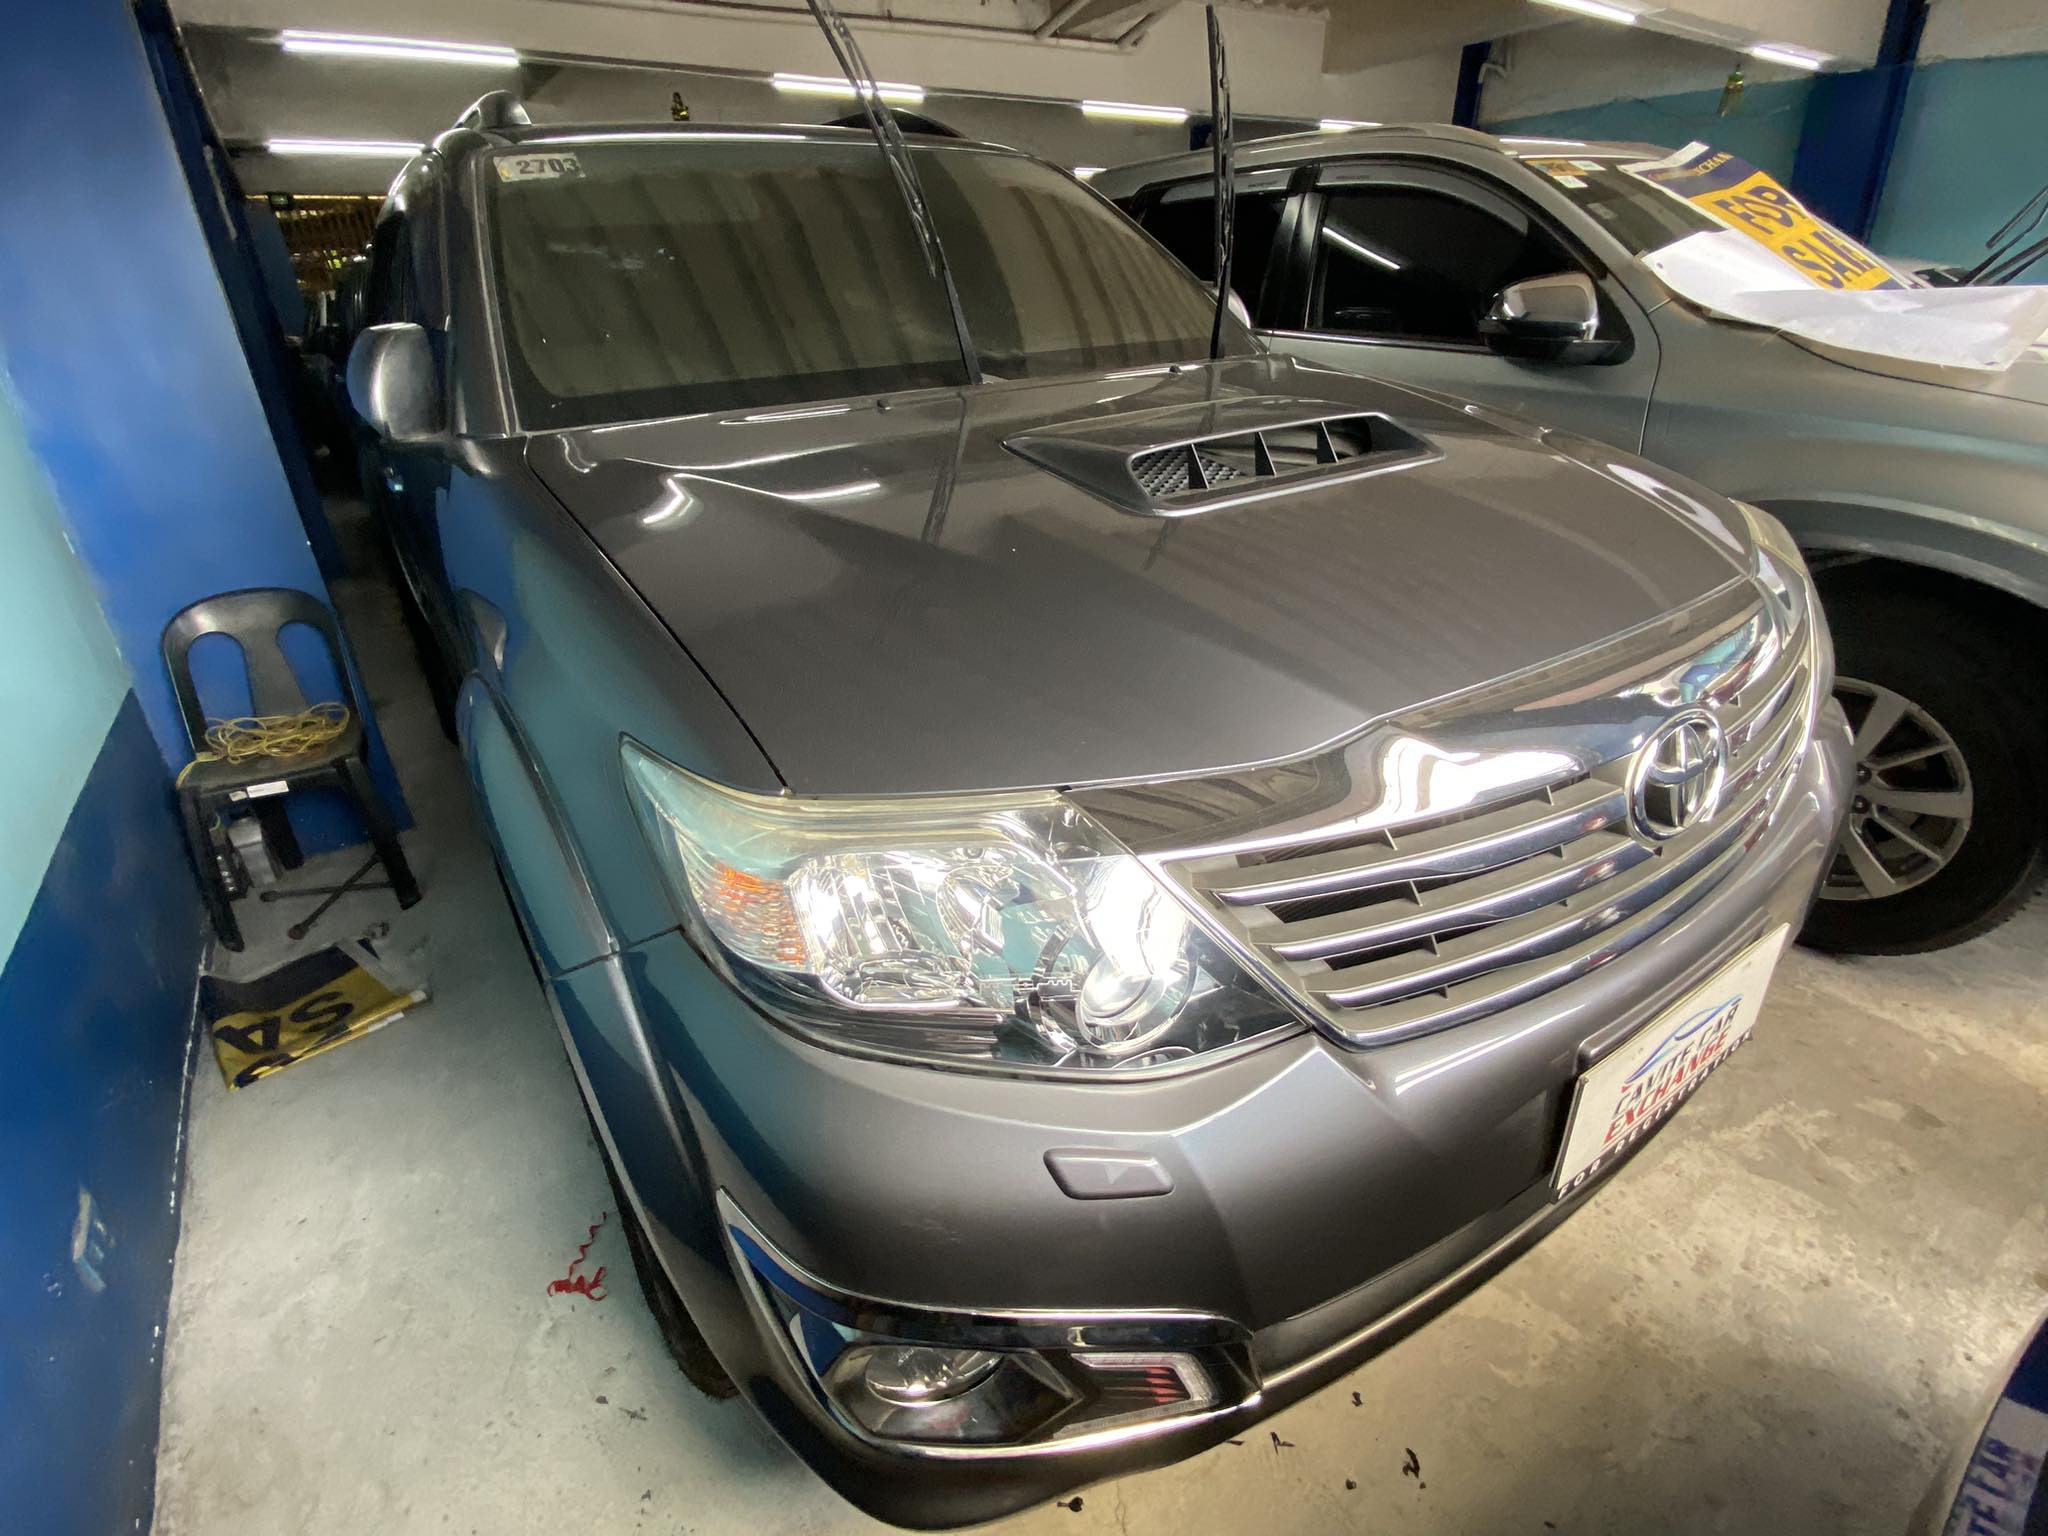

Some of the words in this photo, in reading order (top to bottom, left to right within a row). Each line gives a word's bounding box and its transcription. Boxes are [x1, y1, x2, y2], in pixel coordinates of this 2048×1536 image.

[1712, 185, 1807, 236] FOR
[1557, 1158, 1601, 1200] FOR
[1614, 1027, 1752, 1155] REGISTRATION
[1603, 1024, 1732, 1143] EXCHANGE
[1611, 1040, 1695, 1120] CAVITE
[1697, 1003, 1740, 1049] CAR
